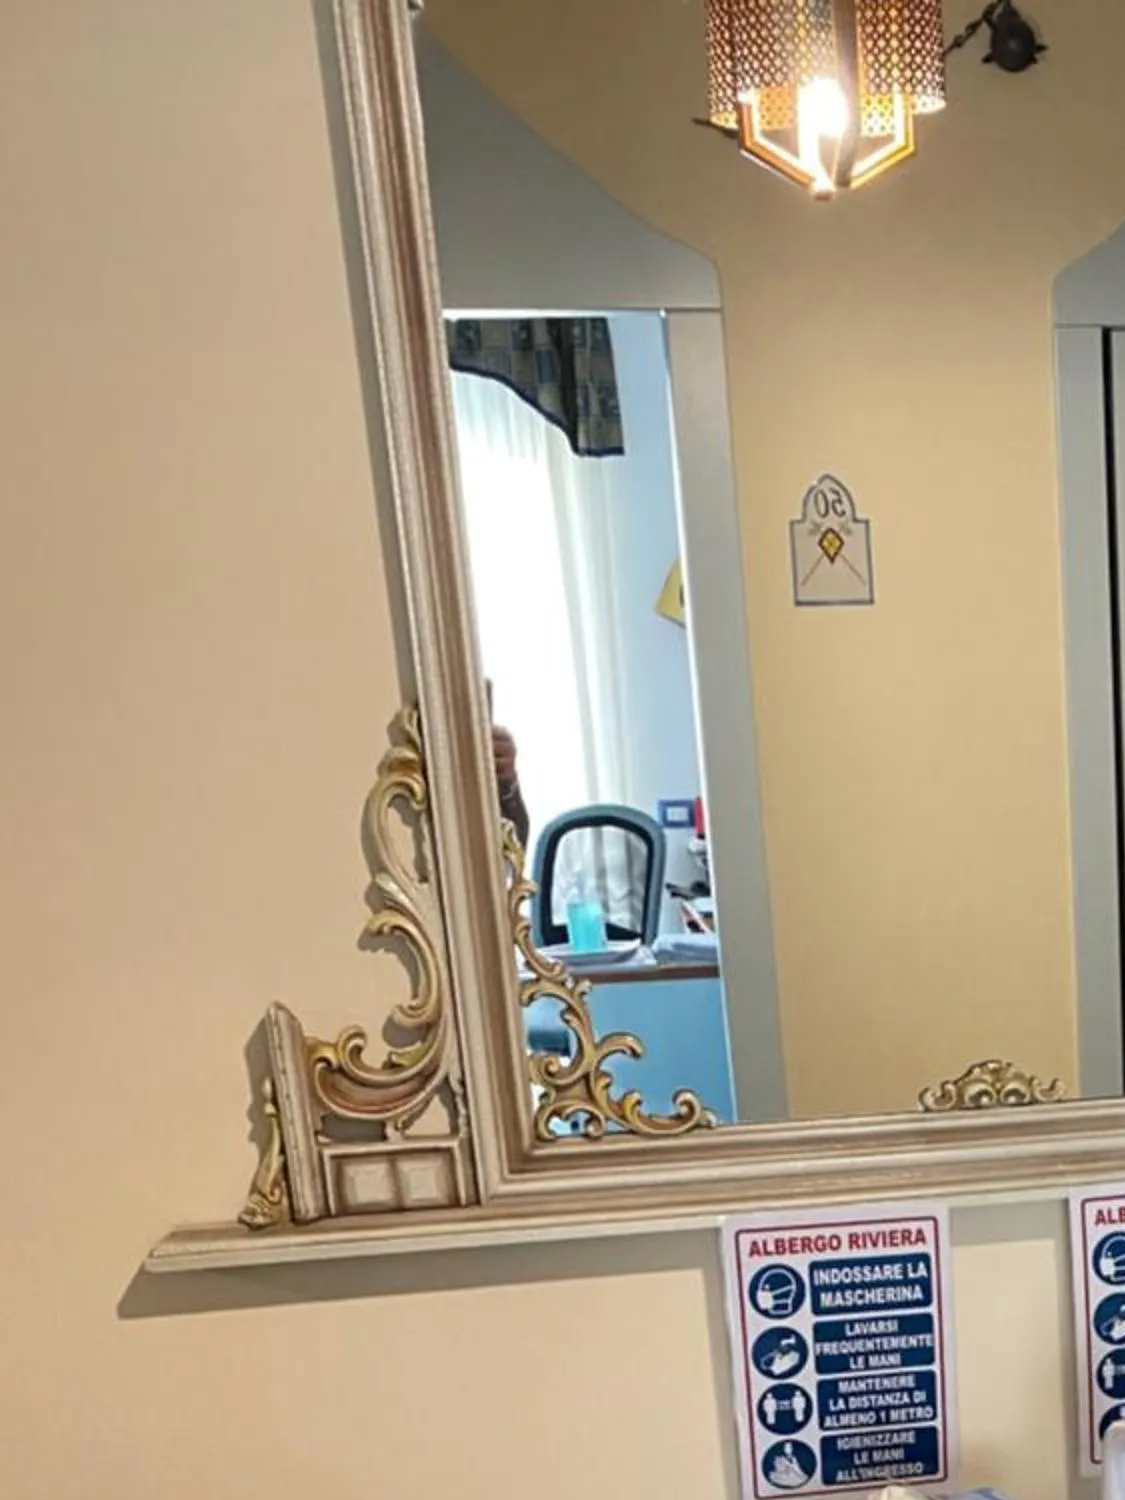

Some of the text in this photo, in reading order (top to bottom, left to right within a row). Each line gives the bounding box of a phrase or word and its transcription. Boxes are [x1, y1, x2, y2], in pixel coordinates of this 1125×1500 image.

[748, 1228, 927, 1257] ALBERGO RIVIERA
[813, 1260, 929, 1287] INDOSSARE LA
[820, 1285, 924, 1309] MASCHERINA
[845, 1320, 898, 1337] LAVARSI
[815, 1333, 934, 1357] FREQUENTEMENTE
[849, 1354, 901, 1370] LE MANI
[838, 1374, 916, 1394] MANTENERE
[829, 1390, 927, 1412] LA DISTANZA DI
[823, 1411, 876, 1428] ALMENO
[890, 1405, 934, 1422] METRO
[836, 1430, 917, 1450] IGIENIZZARE
[853, 1448, 905, 1465] LE MANI
